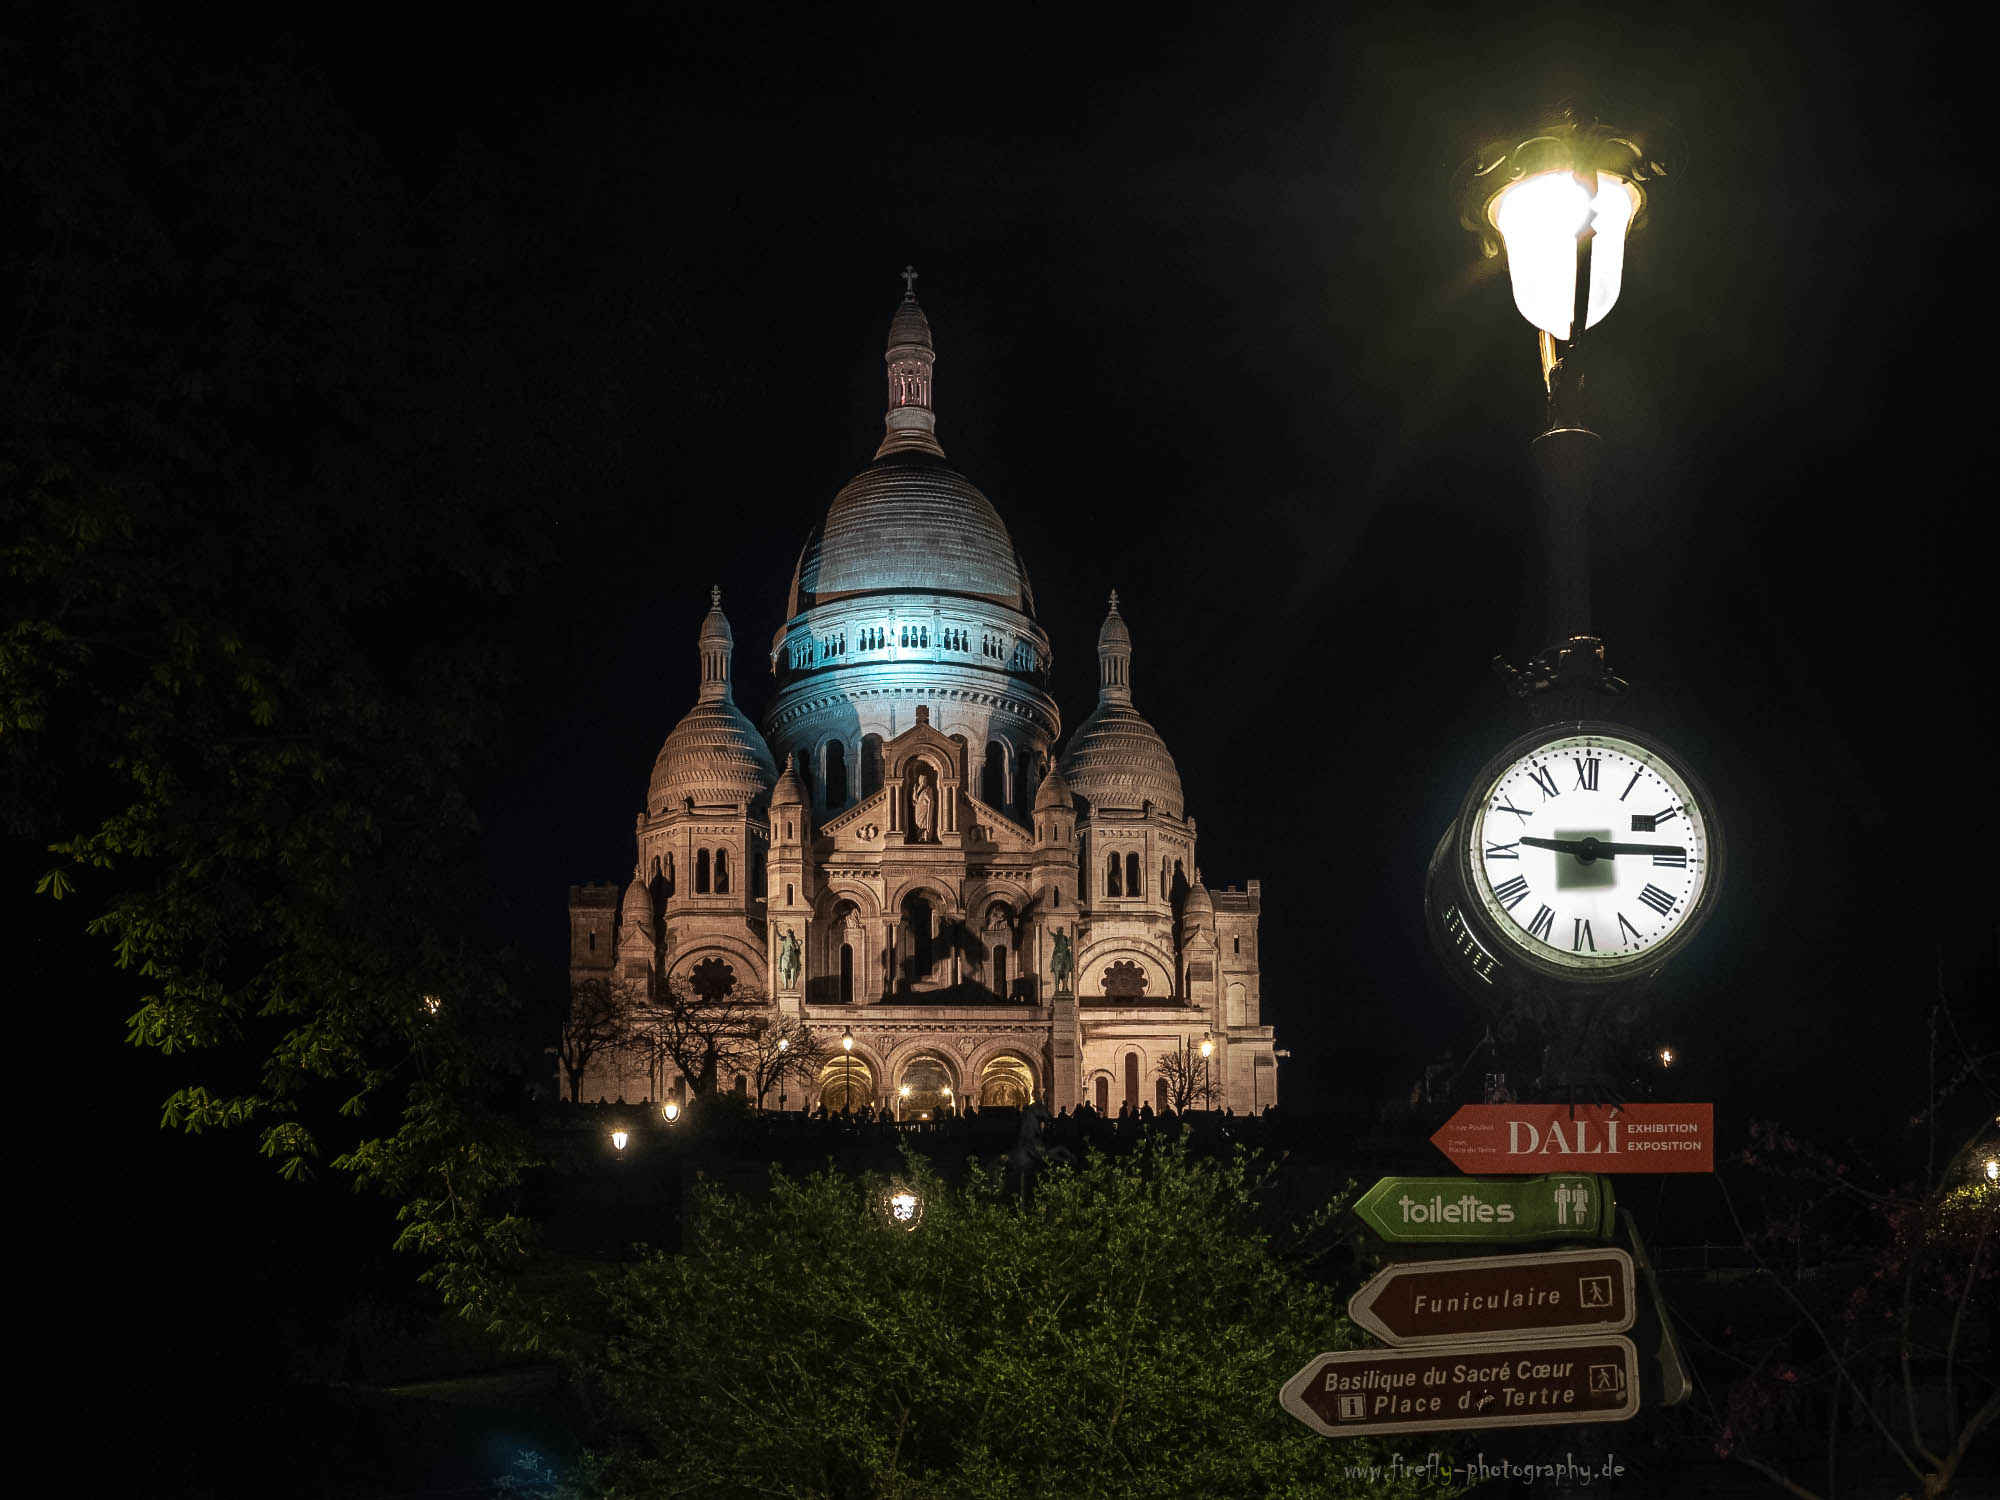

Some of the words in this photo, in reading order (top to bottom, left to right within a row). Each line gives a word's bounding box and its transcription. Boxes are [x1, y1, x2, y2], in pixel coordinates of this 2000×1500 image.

[1527, 765, 1560, 802] XI
[1573, 757, 1601, 791] XII
[1619, 771, 1642, 801] I
[1496, 795, 1534, 826] X
[1652, 851, 1687, 869] II
[1506, 1107, 1623, 1154] DALÍ
[1627, 1123, 1698, 1134] EXHIBITION
[1627, 1141, 1702, 1152] EXPOSITION
[1398, 1194, 1516, 1224] toilettes
[1414, 1287, 1561, 1315] Funiculaire
[1325, 1370, 1417, 1393] Basilique
[1423, 1366, 1448, 1387] du
[1452, 1361, 1511, 1384] Sacré
[1516, 1360, 1574, 1381] Cœur
[1374, 1394, 1442, 1417] Place
[1502, 1387, 1576, 1408] Tertre
